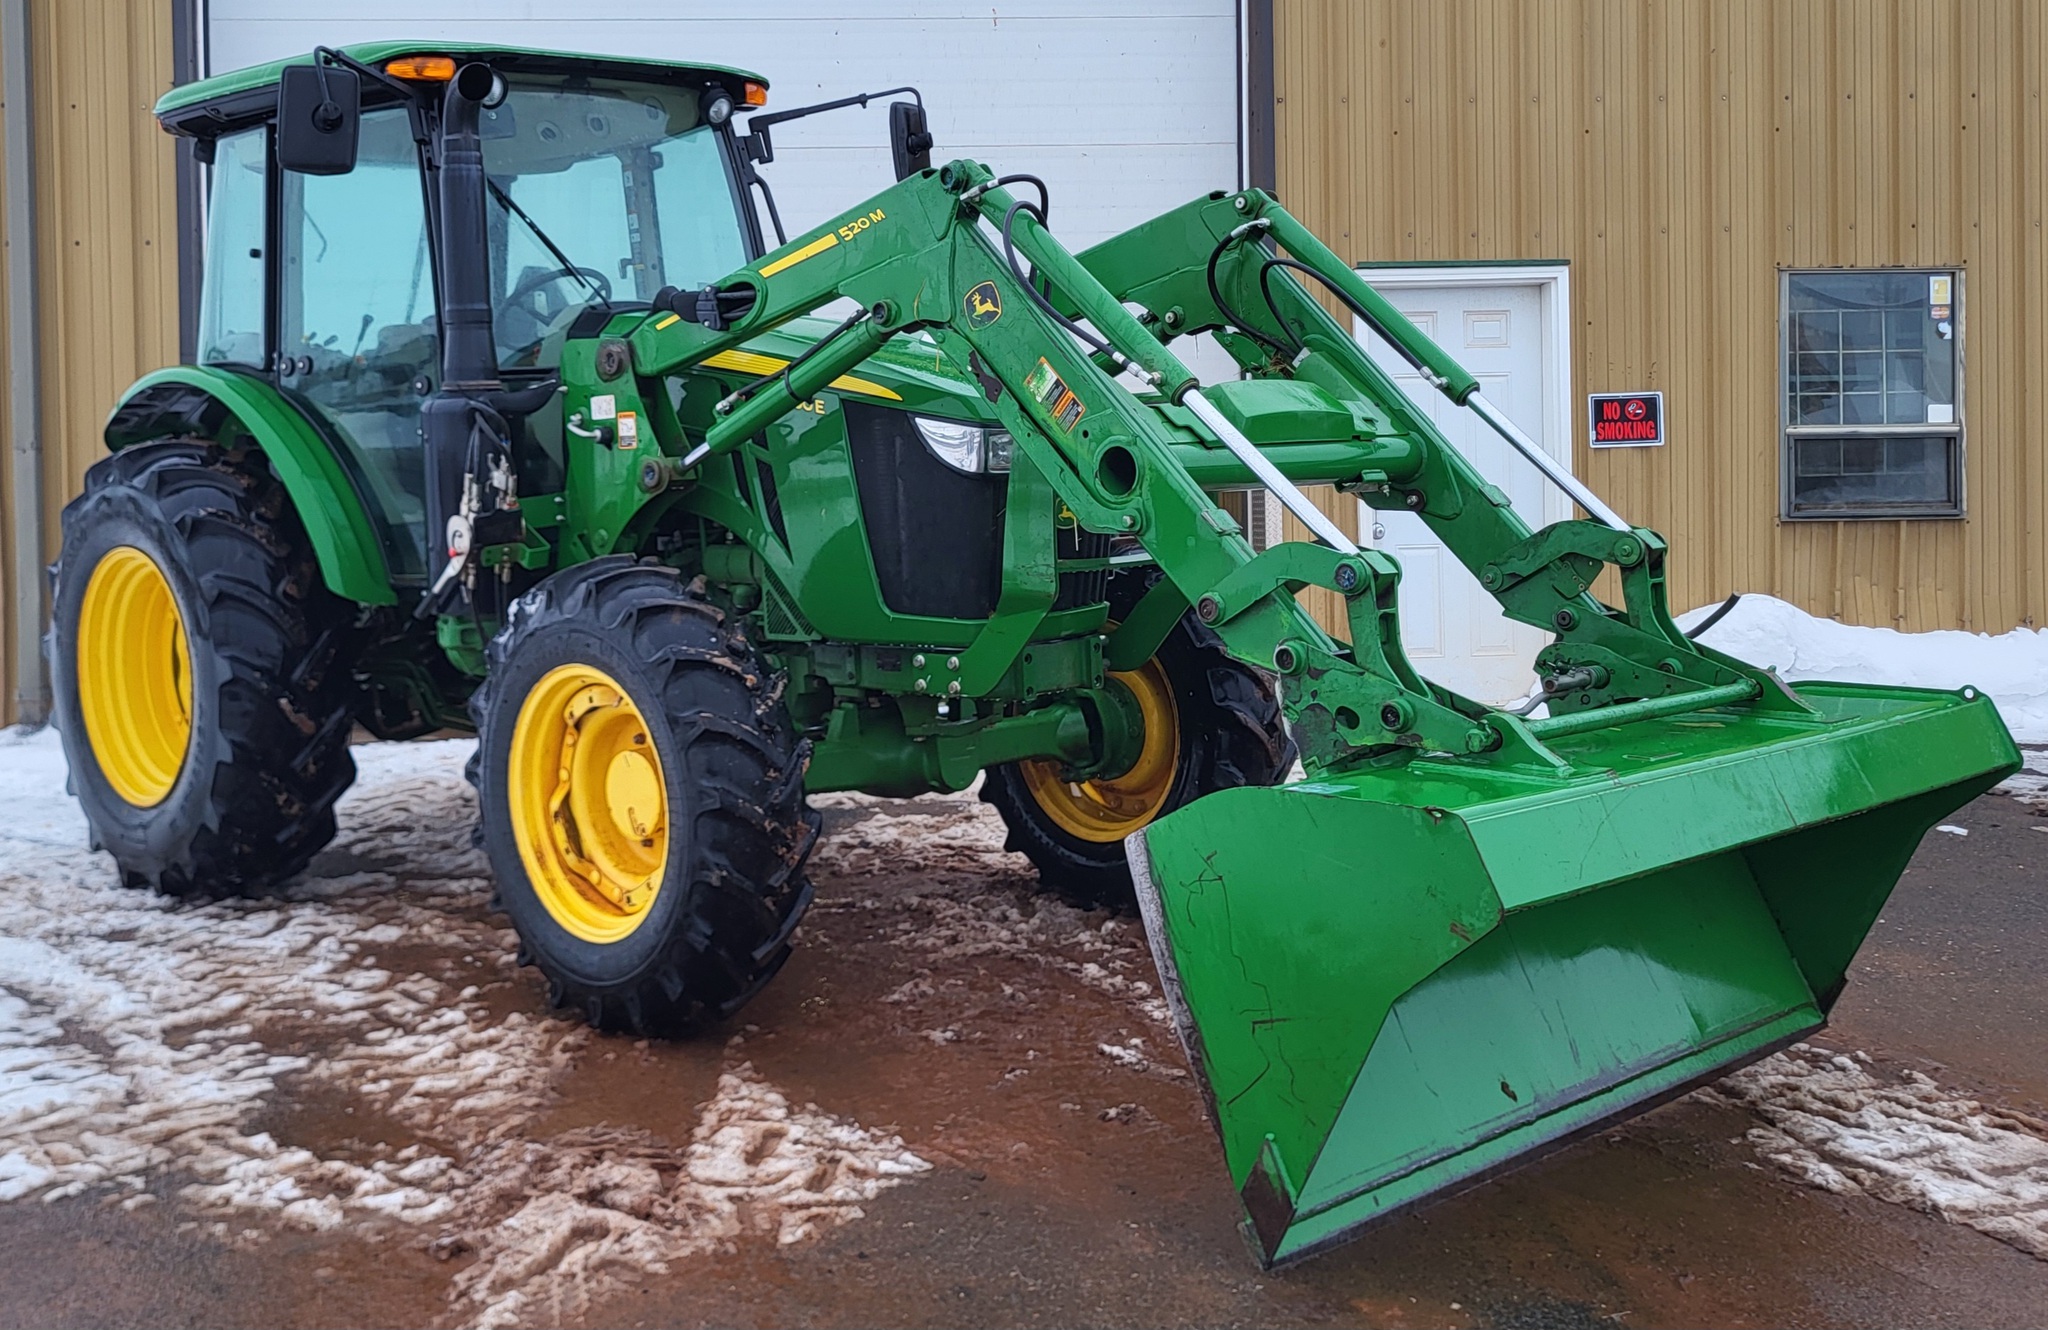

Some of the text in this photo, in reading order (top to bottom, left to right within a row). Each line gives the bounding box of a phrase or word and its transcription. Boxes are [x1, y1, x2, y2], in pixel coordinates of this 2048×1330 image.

[838, 217, 870, 241] 520
[1603, 401, 1620, 420] NO
[1597, 421, 1656, 440] SMOKING
